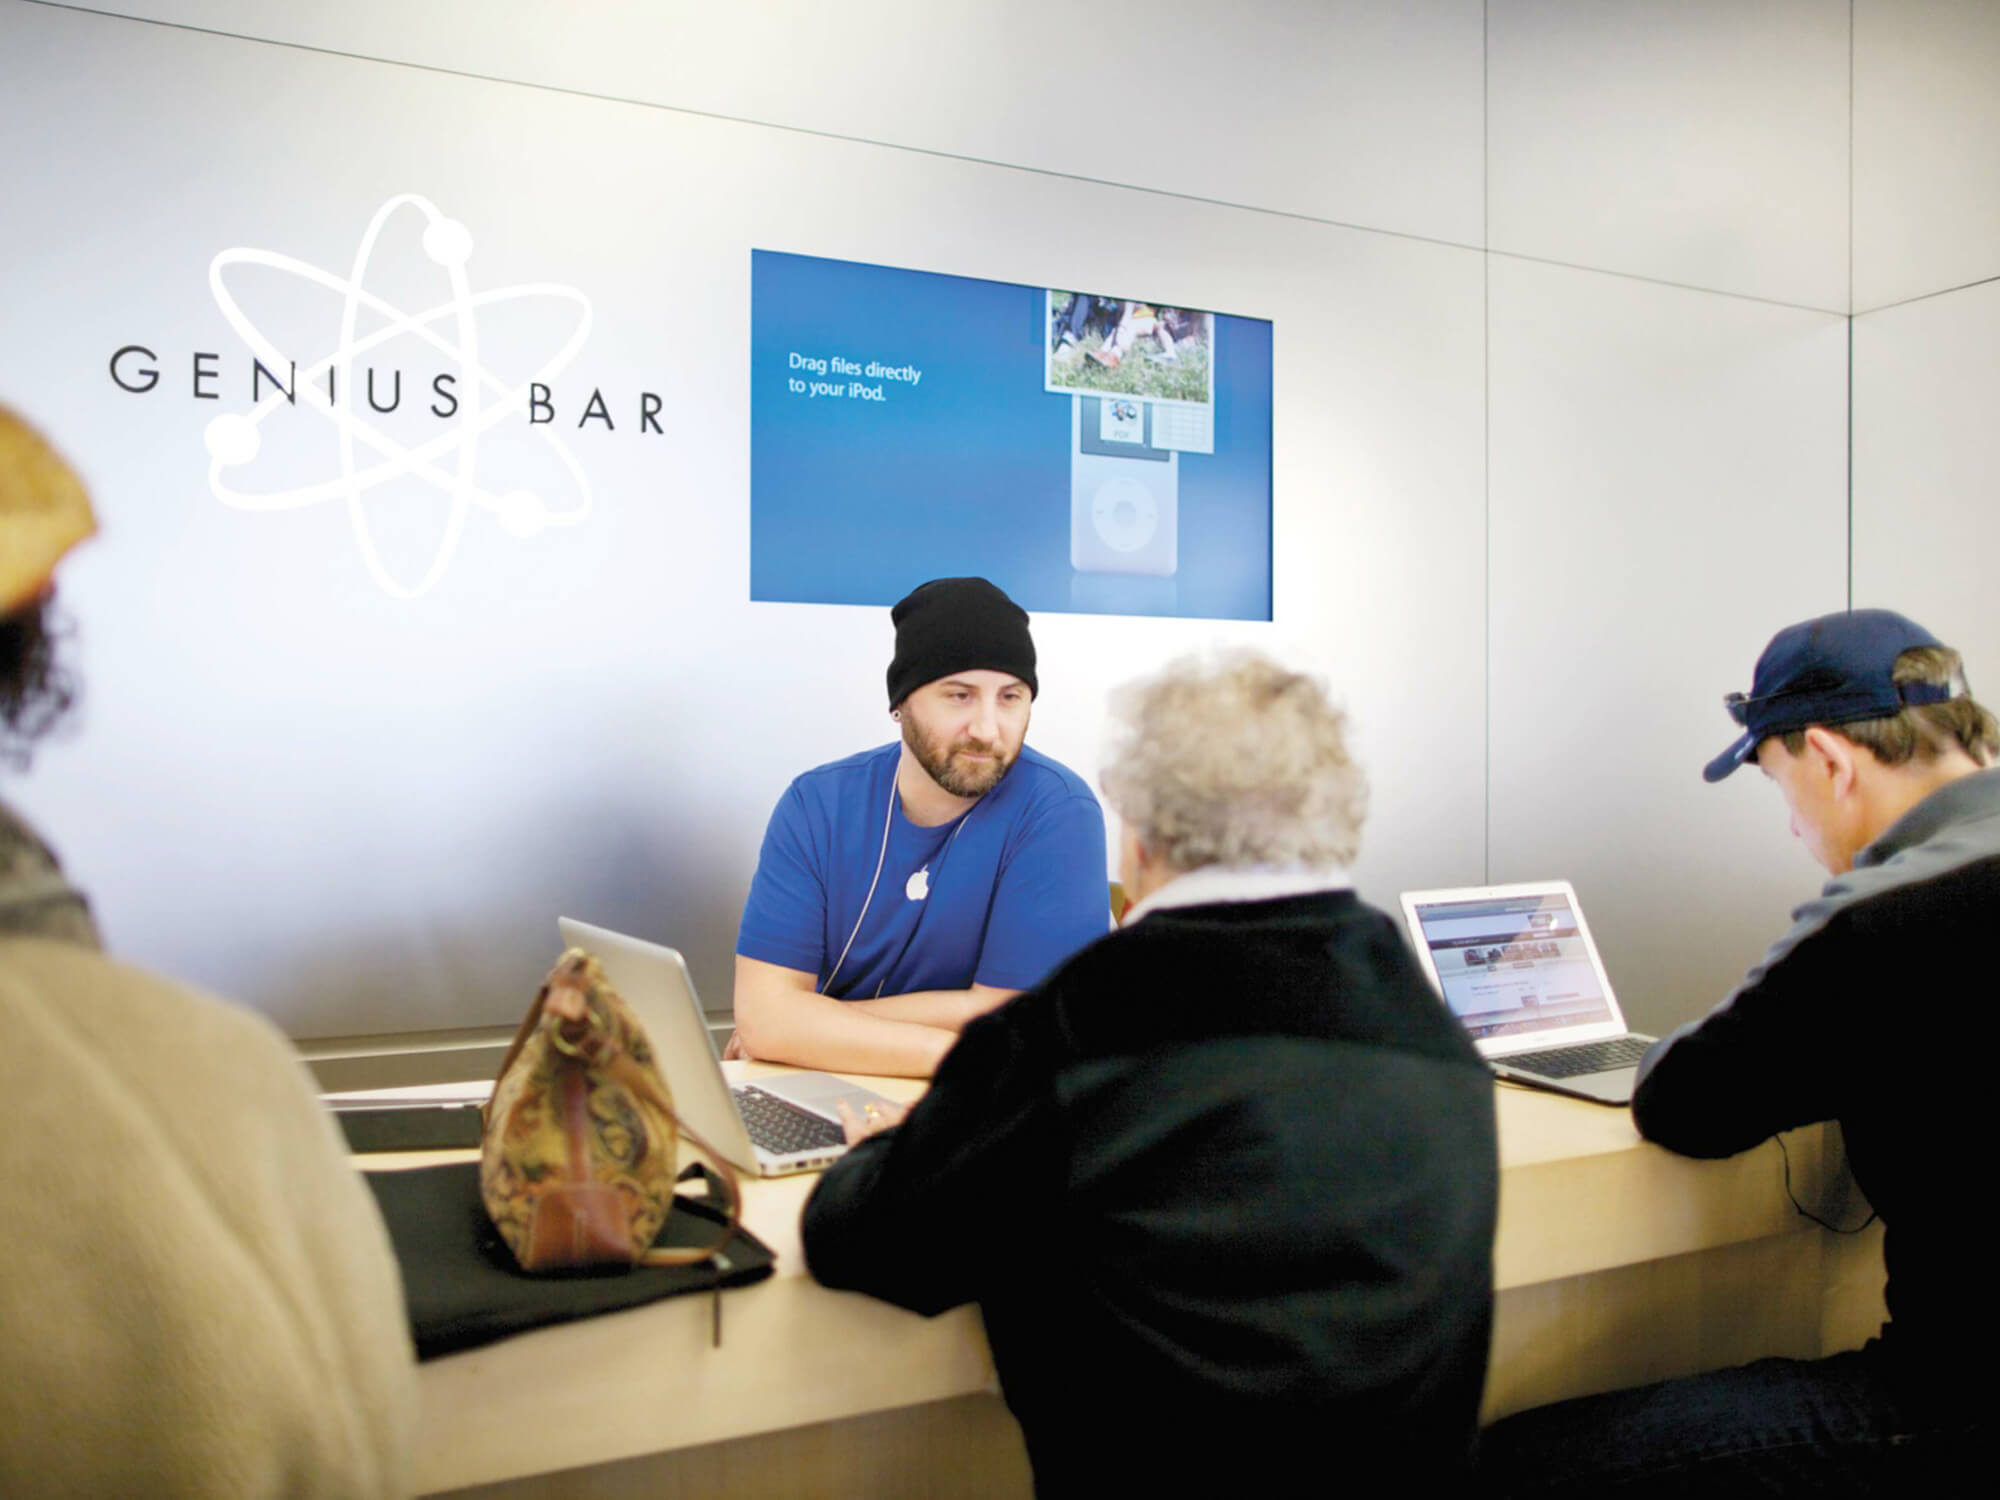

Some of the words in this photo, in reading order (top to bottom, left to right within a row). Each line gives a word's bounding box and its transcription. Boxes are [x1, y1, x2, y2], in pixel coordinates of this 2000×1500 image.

[789, 352, 827, 376] Drag
[831, 357, 862, 376] files
[865, 362, 921, 385] directly
[109, 345, 458, 418] GENIUS
[529, 383, 665, 435] BAR
[788, 377, 806, 393] to
[809, 382, 845, 398] your
[848, 383, 886, 401] iPod.
